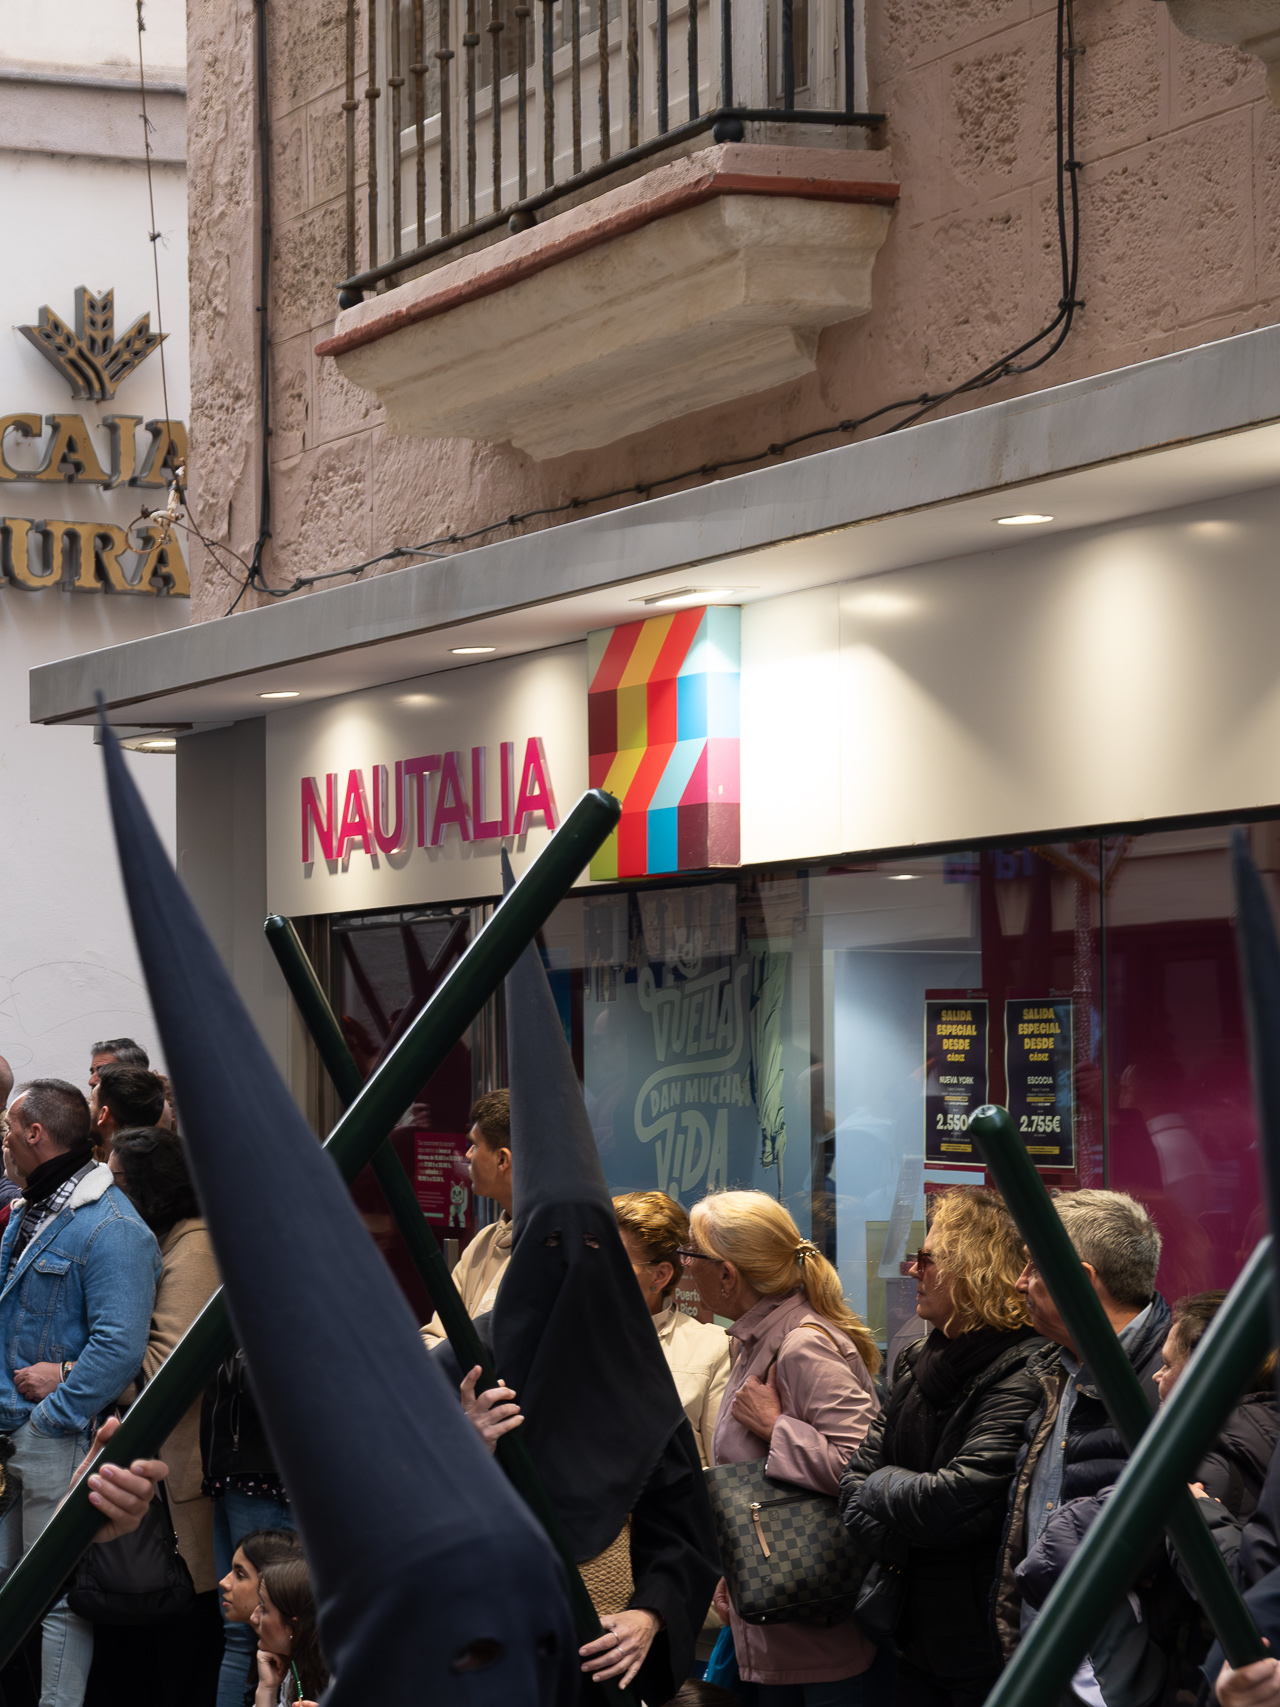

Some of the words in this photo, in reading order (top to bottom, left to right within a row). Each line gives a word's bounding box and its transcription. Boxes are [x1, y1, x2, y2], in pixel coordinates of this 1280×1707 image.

[300, 736, 560, 864] NAUTALIA
[637, 962, 750, 1062] VUELTAS
[941, 1010, 972, 1021] SALIDA
[1023, 1008, 1055, 1020] SALIDA
[936, 1024, 977, 1036] ESPECIAL
[1018, 1022, 1061, 1035] ESPECIAL
[942, 1038, 971, 1050] DESDE
[1024, 1037, 1055, 1050] DESDE
[946, 1052, 966, 1062] CÁDIZ
[1028, 1051, 1049, 1062] CÁDIZ
[939, 1076, 958, 1085] NUEVA
[649, 1081, 681, 1118] DAN
[684, 1073, 742, 1107] MUCHA
[936, 1113, 970, 1132] 2.550
[1020, 1115, 1062, 1133] 2.755€
